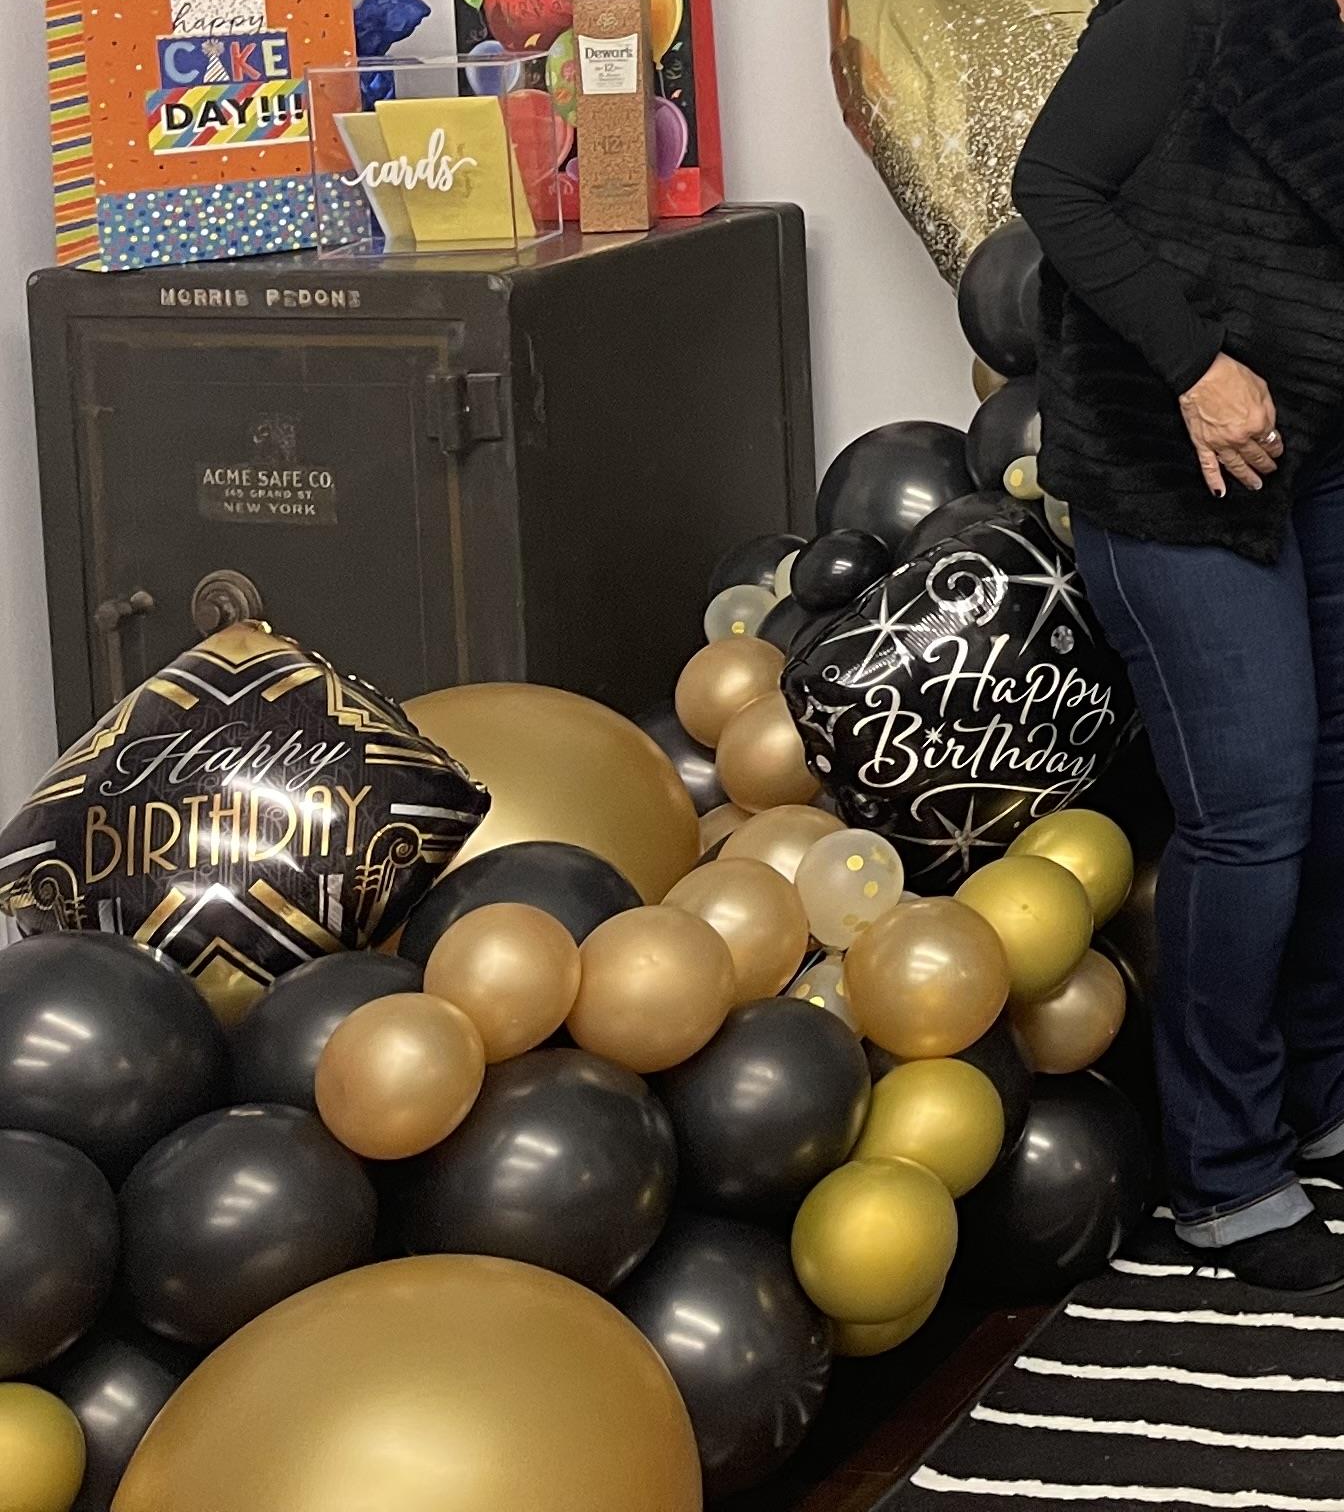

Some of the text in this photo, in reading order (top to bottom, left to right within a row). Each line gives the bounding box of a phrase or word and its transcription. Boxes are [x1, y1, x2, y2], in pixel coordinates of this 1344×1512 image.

[171, 2, 265, 37] happy
[160, 93, 304, 136] DAY!!!
[340, 128, 478, 192] cards
[203, 468, 336, 489] ACME SAFE CO.
[223, 501, 316, 516] NEW YORK
[921, 633, 1116, 746] Happy
[99, 720, 352, 798] Happy
[852, 683, 1099, 823] Birthday
[84, 784, 374, 885] BIRTHDAY
